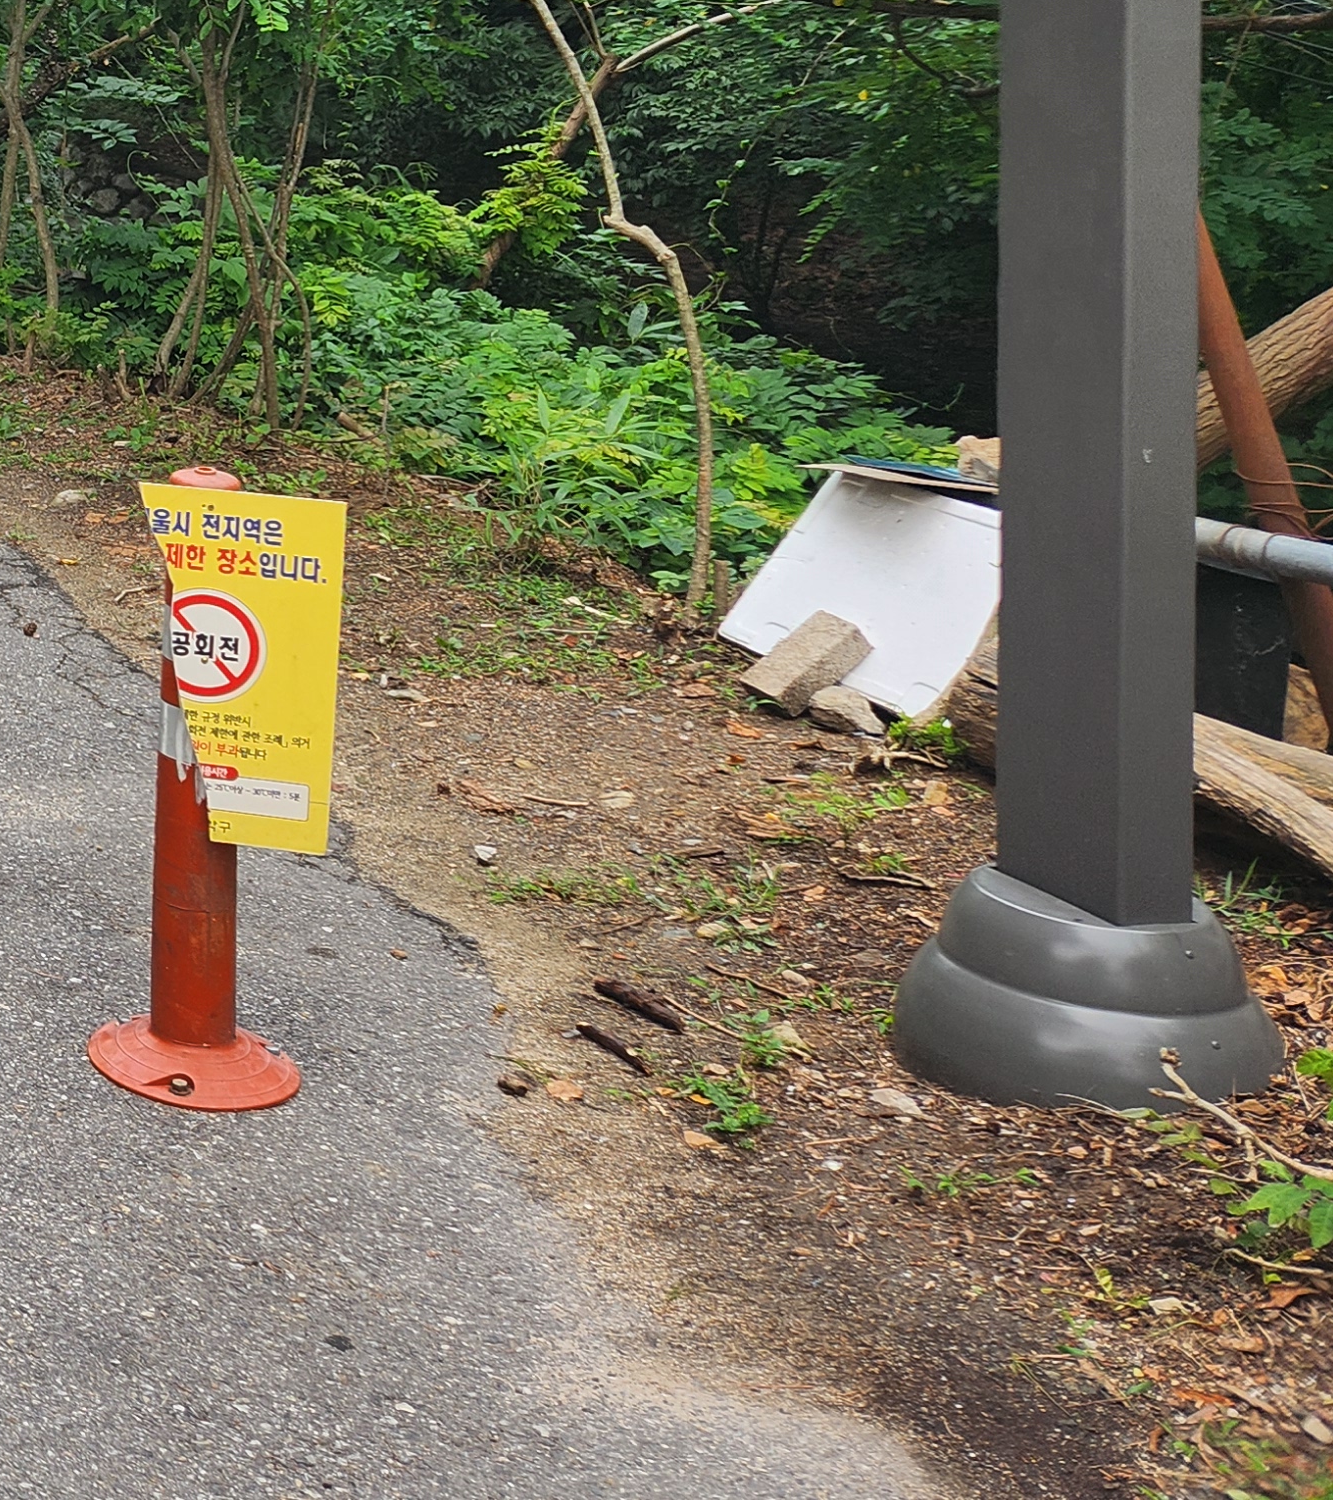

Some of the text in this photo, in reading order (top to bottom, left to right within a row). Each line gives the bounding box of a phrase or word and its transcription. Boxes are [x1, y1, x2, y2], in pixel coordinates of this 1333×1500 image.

[145, 507, 283, 546] 울시 전지역은
[165, 543, 327, 585] 제한 장소입니다.
[172, 631, 239, 662] 공회전
[201, 711, 220, 724] 규정
[223, 713, 251, 728] 위반시
[209, 727, 238, 741] 제한에
[241, 730, 261, 743] 관한
[291, 736, 310, 749] 의거
[215, 743, 267, 761] 부과됩니다
